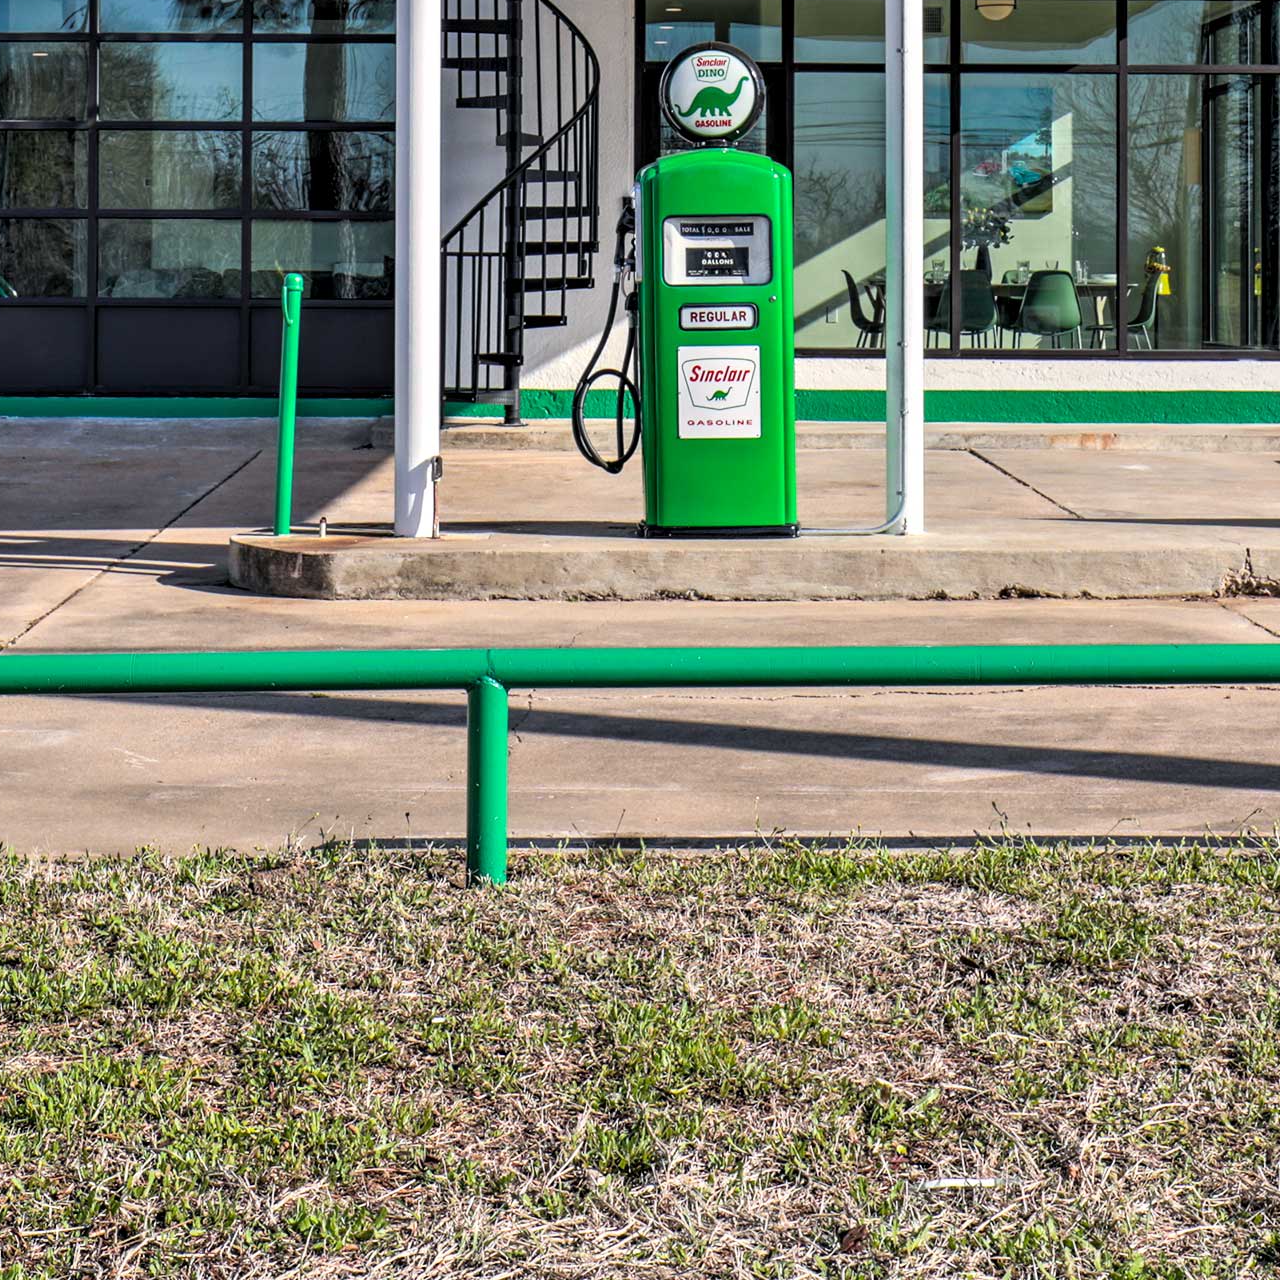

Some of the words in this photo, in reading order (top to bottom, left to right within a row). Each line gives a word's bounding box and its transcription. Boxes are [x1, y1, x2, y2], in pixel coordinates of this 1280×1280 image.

[696, 56, 727, 68] Sinclair
[698, 68, 725, 78] DINO
[695, 119, 732, 128] GASOLINE
[701, 258, 734, 266] GALLONS
[689, 311, 747, 323] REGULAR
[689, 365, 750, 383] Sinclair
